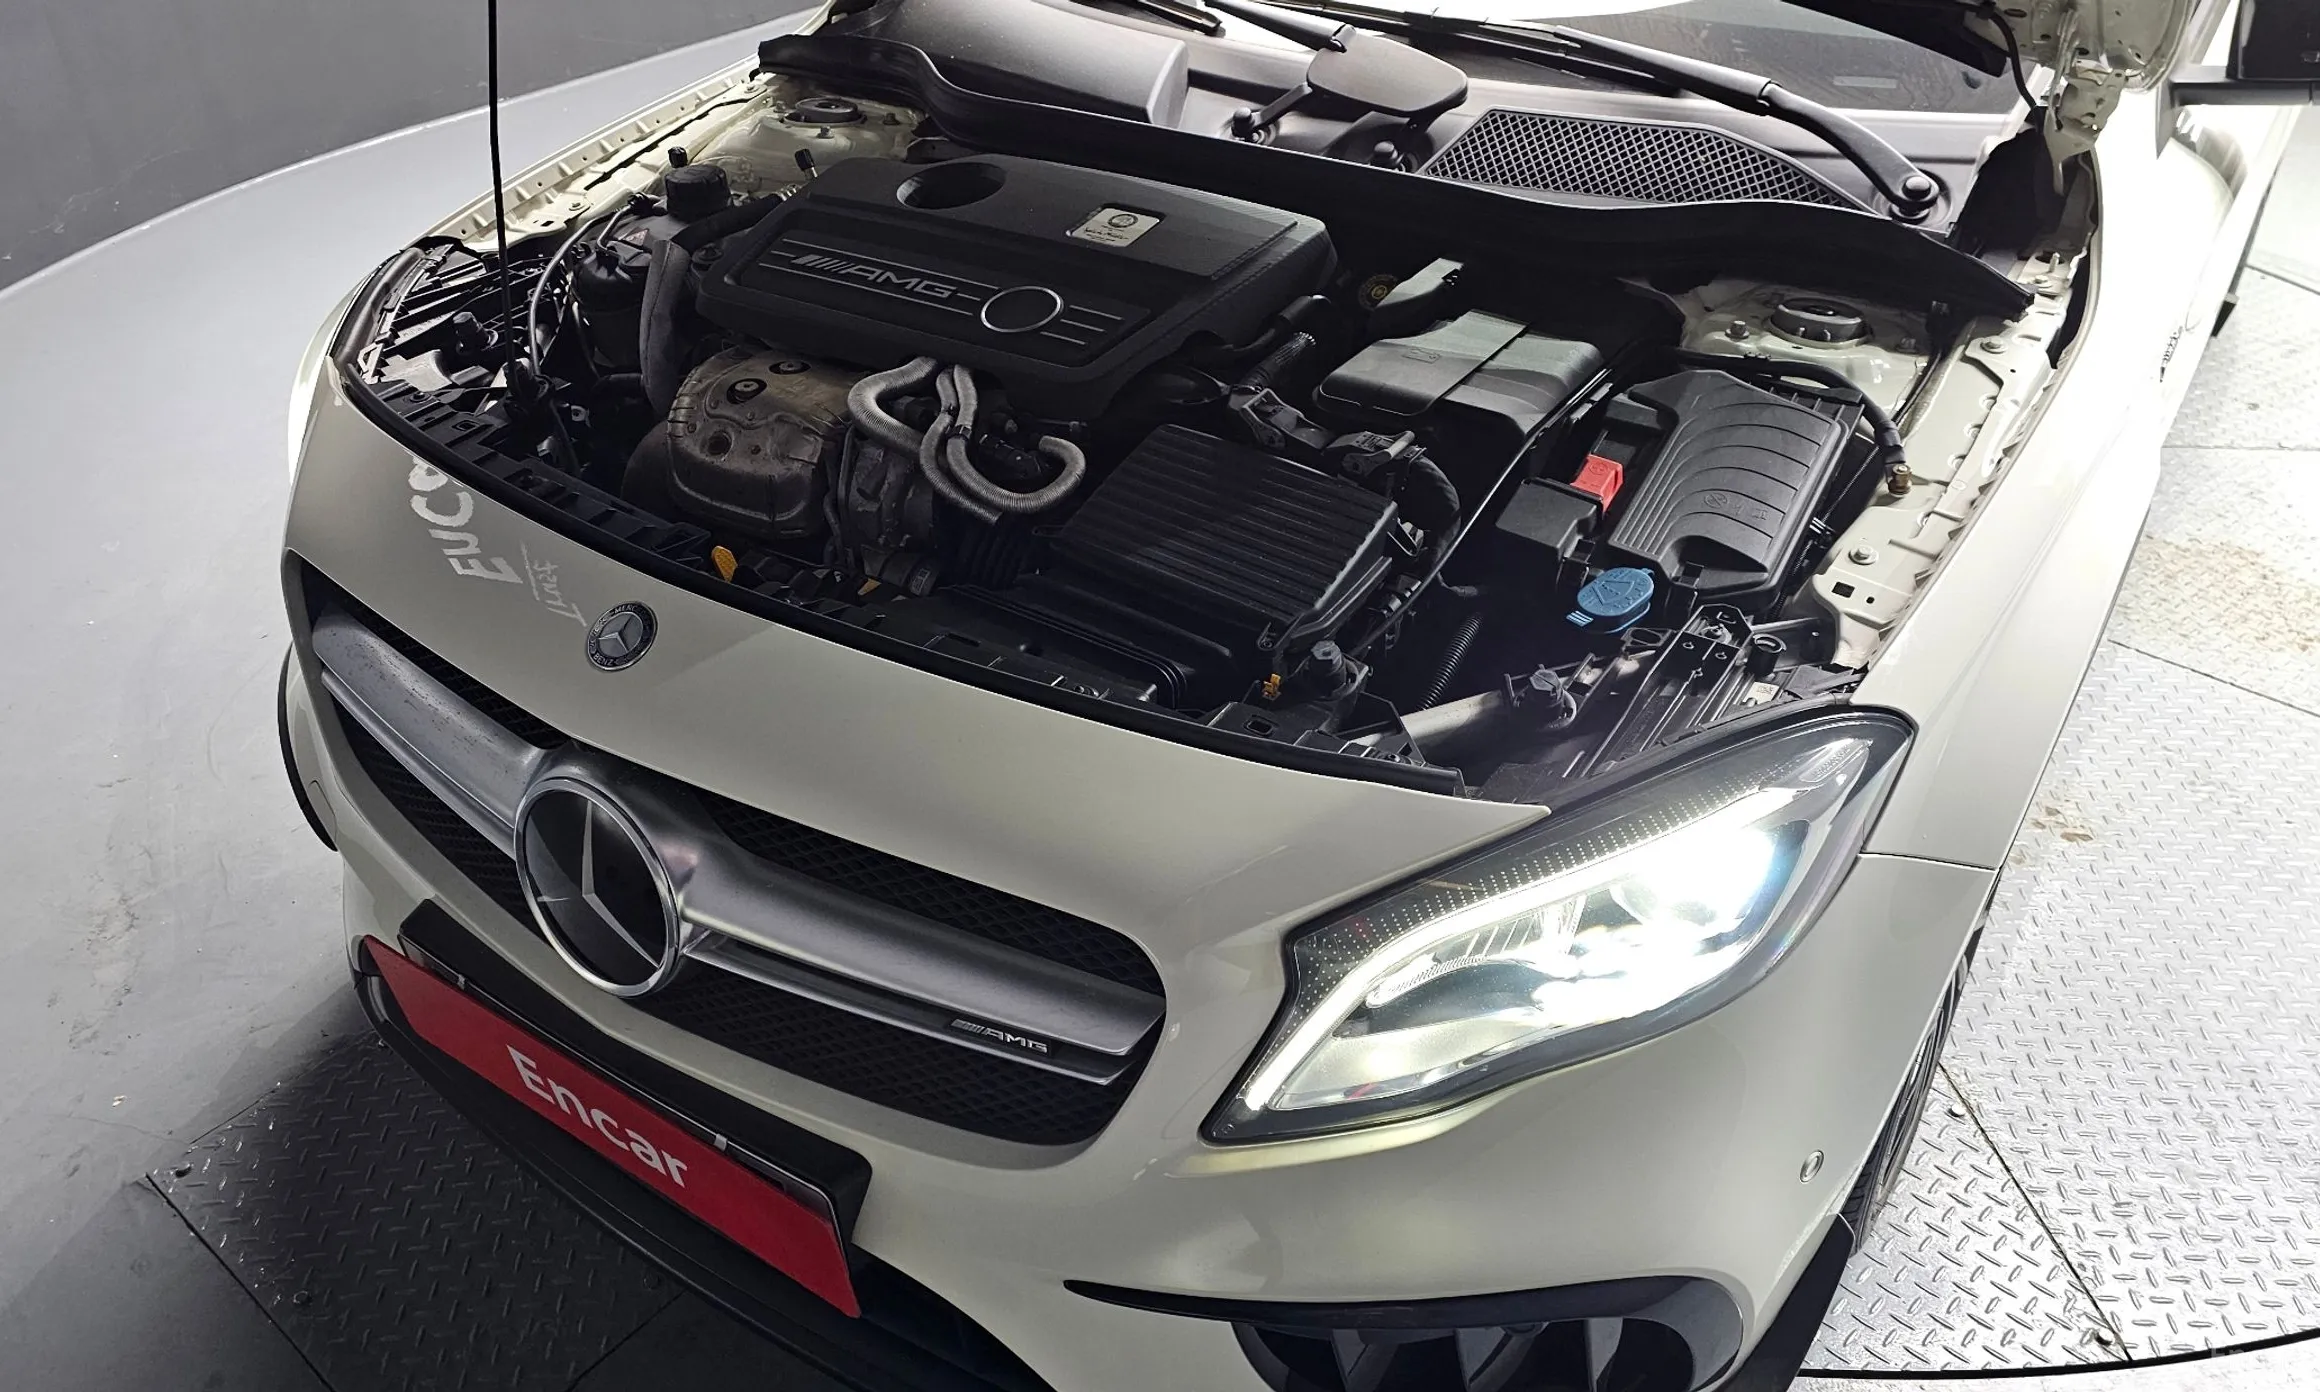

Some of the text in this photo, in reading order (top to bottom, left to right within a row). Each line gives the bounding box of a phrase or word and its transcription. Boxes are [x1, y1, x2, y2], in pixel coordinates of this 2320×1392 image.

[836, 262, 958, 298] AMG
[593, 653, 614, 667] BENZ
[980, 1026, 1048, 1054] AMG
[506, 1044, 688, 1188] Encar
